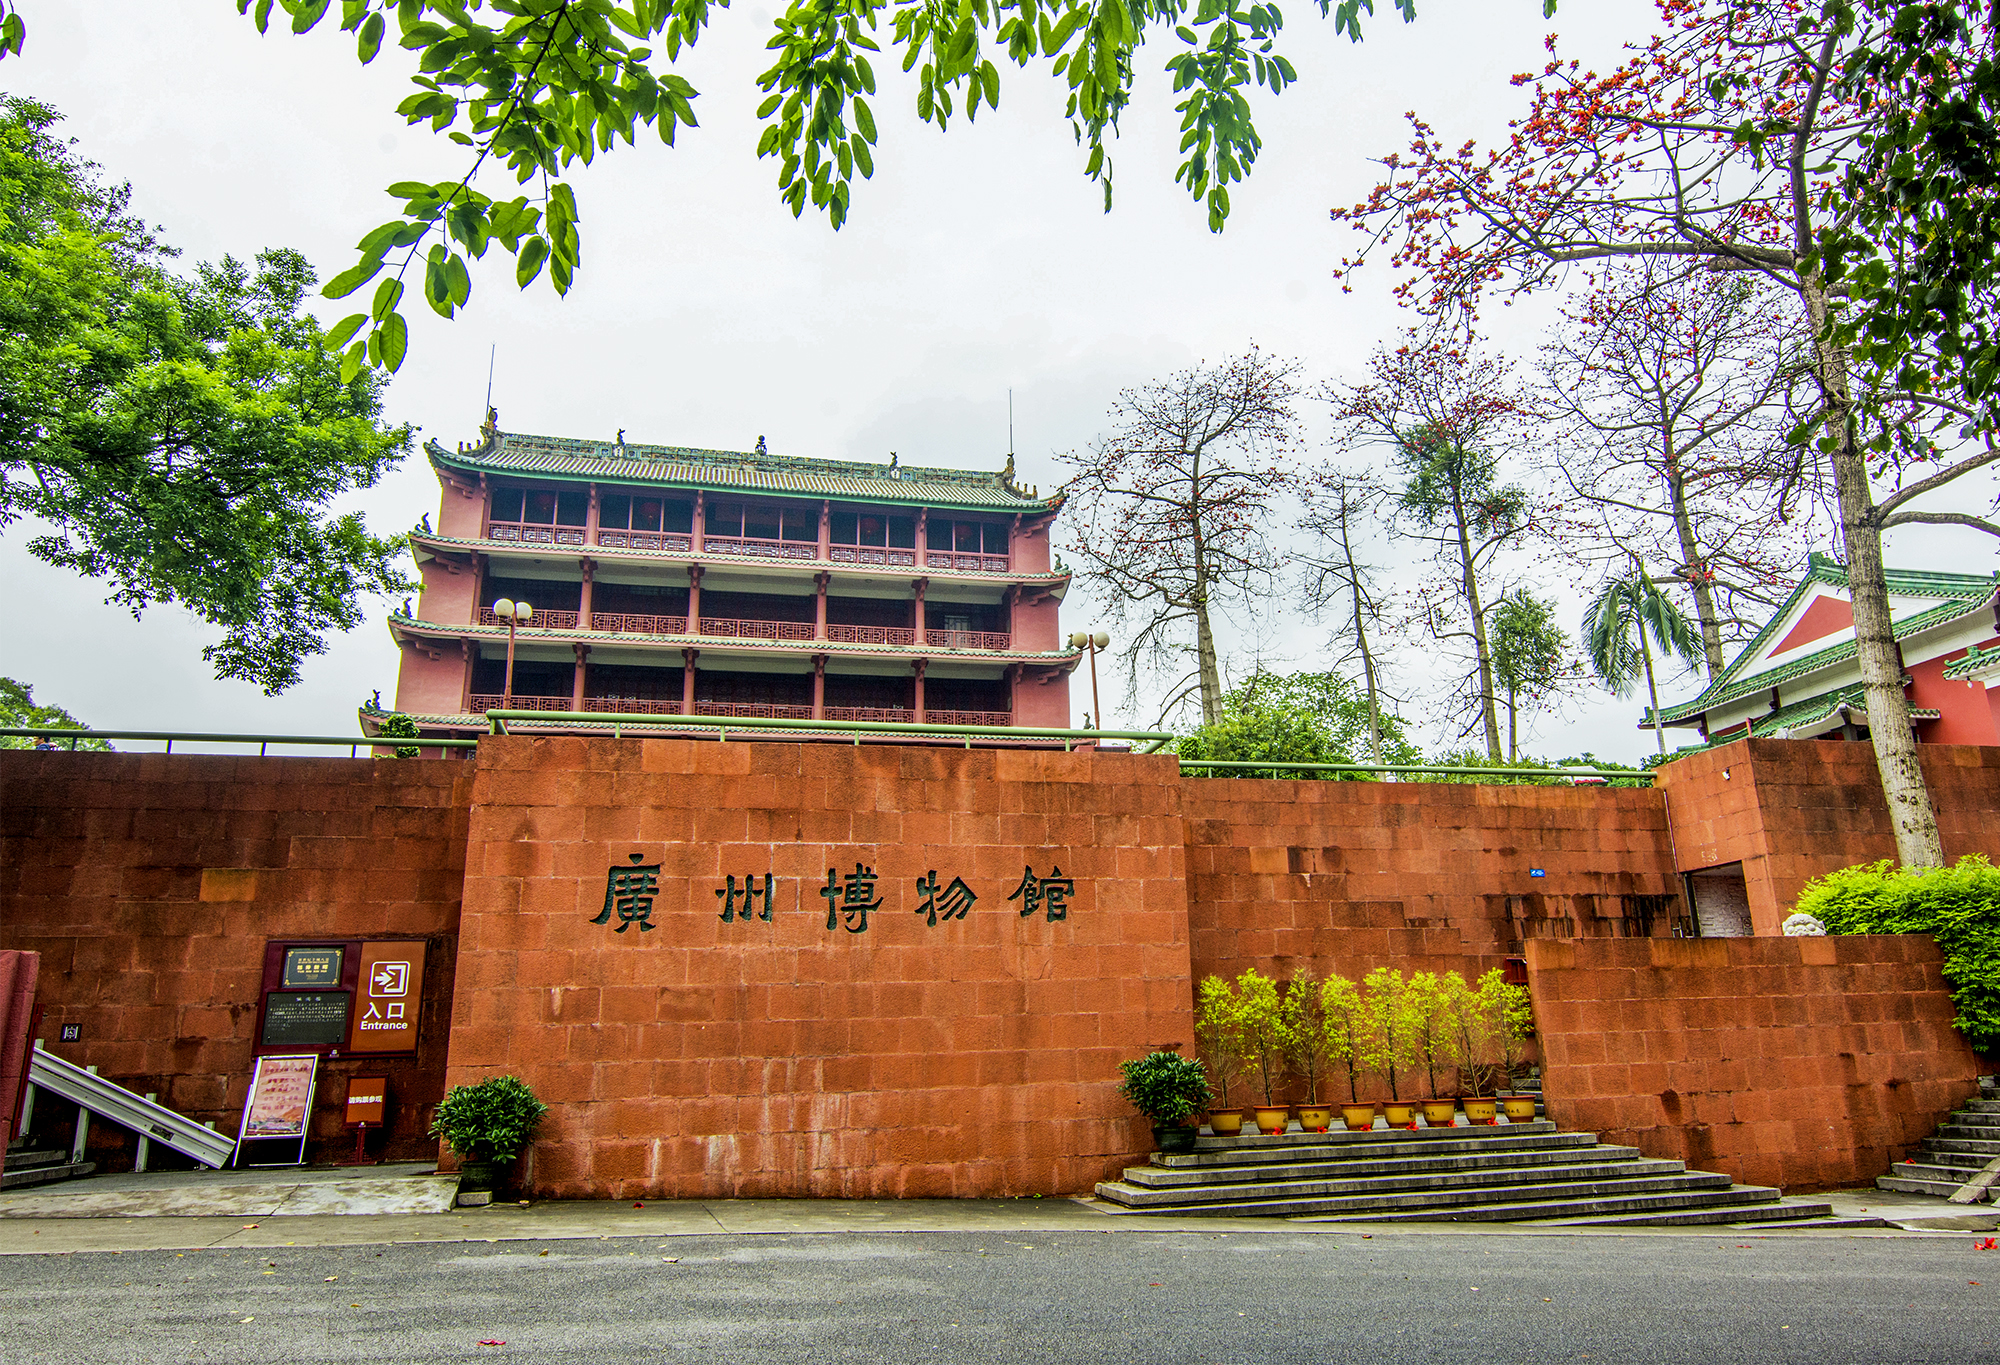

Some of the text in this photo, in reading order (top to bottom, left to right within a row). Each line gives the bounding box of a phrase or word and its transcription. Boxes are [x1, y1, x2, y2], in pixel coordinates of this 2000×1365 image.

[590, 853, 1074, 934] 廣州博物館
[362, 1002, 405, 1019] 入口
[359, 1021, 408, 1030] Entrance
